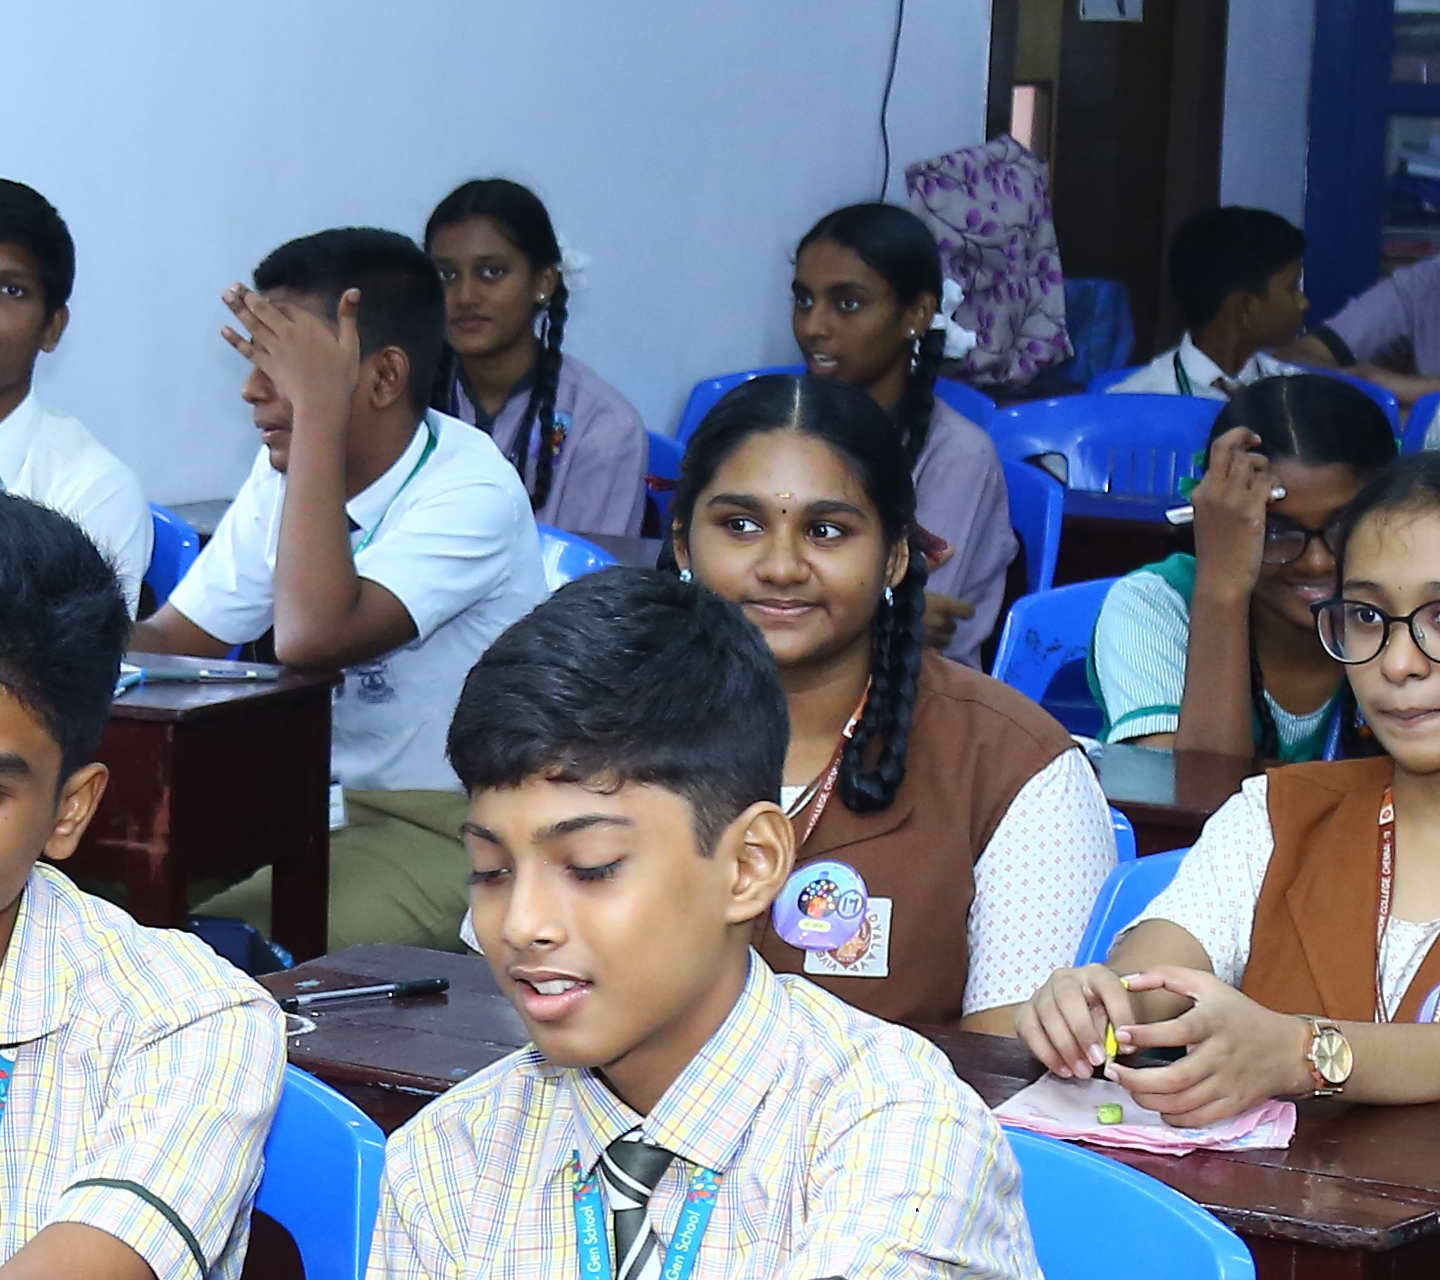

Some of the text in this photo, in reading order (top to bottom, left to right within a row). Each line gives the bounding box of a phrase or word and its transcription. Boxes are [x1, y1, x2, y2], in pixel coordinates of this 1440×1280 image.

[842, 897, 859, 913] 17
[580, 1205, 599, 1245] School
[674, 1209, 701, 1255] School
[587, 1249, 602, 1273] Gen
